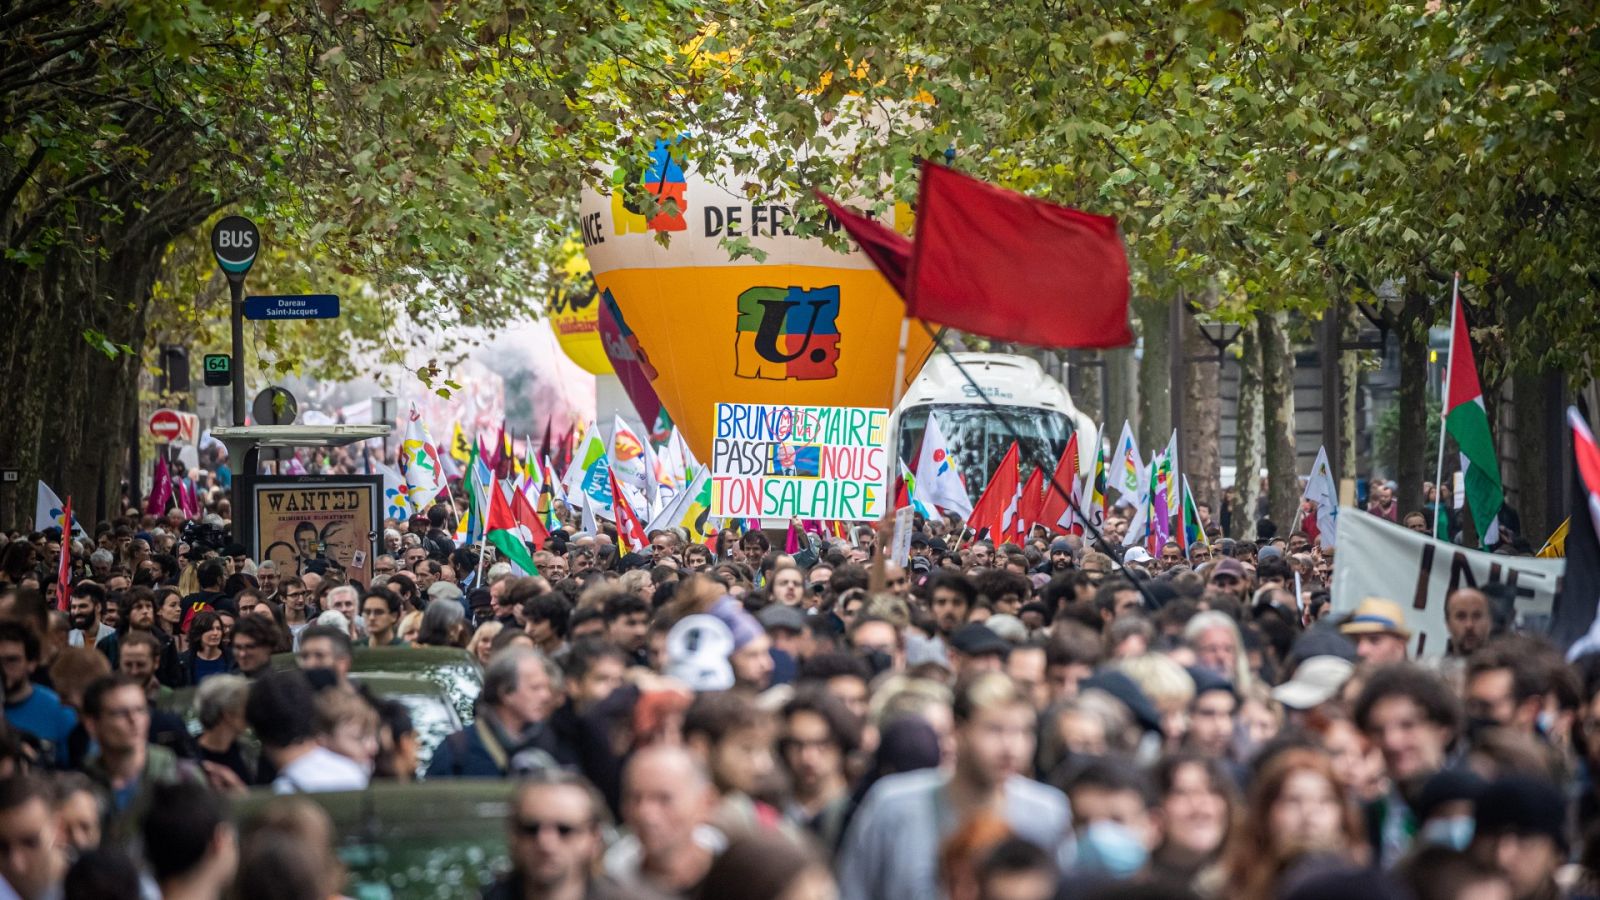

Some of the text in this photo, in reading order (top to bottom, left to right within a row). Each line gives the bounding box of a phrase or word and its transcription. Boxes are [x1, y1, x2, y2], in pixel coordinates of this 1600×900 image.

[704, 206, 742, 237] DE
[219, 229, 253, 248] BUS
[266, 307, 319, 316] Saint-Jacques
[278, 299, 306, 307] Dareau
[209, 358, 226, 370] 64
[717, 403, 792, 441] BRUNO
[714, 438, 884, 482] PASSE NOUS
[267, 491, 359, 512] WANTED
[713, 476, 764, 516] TON
